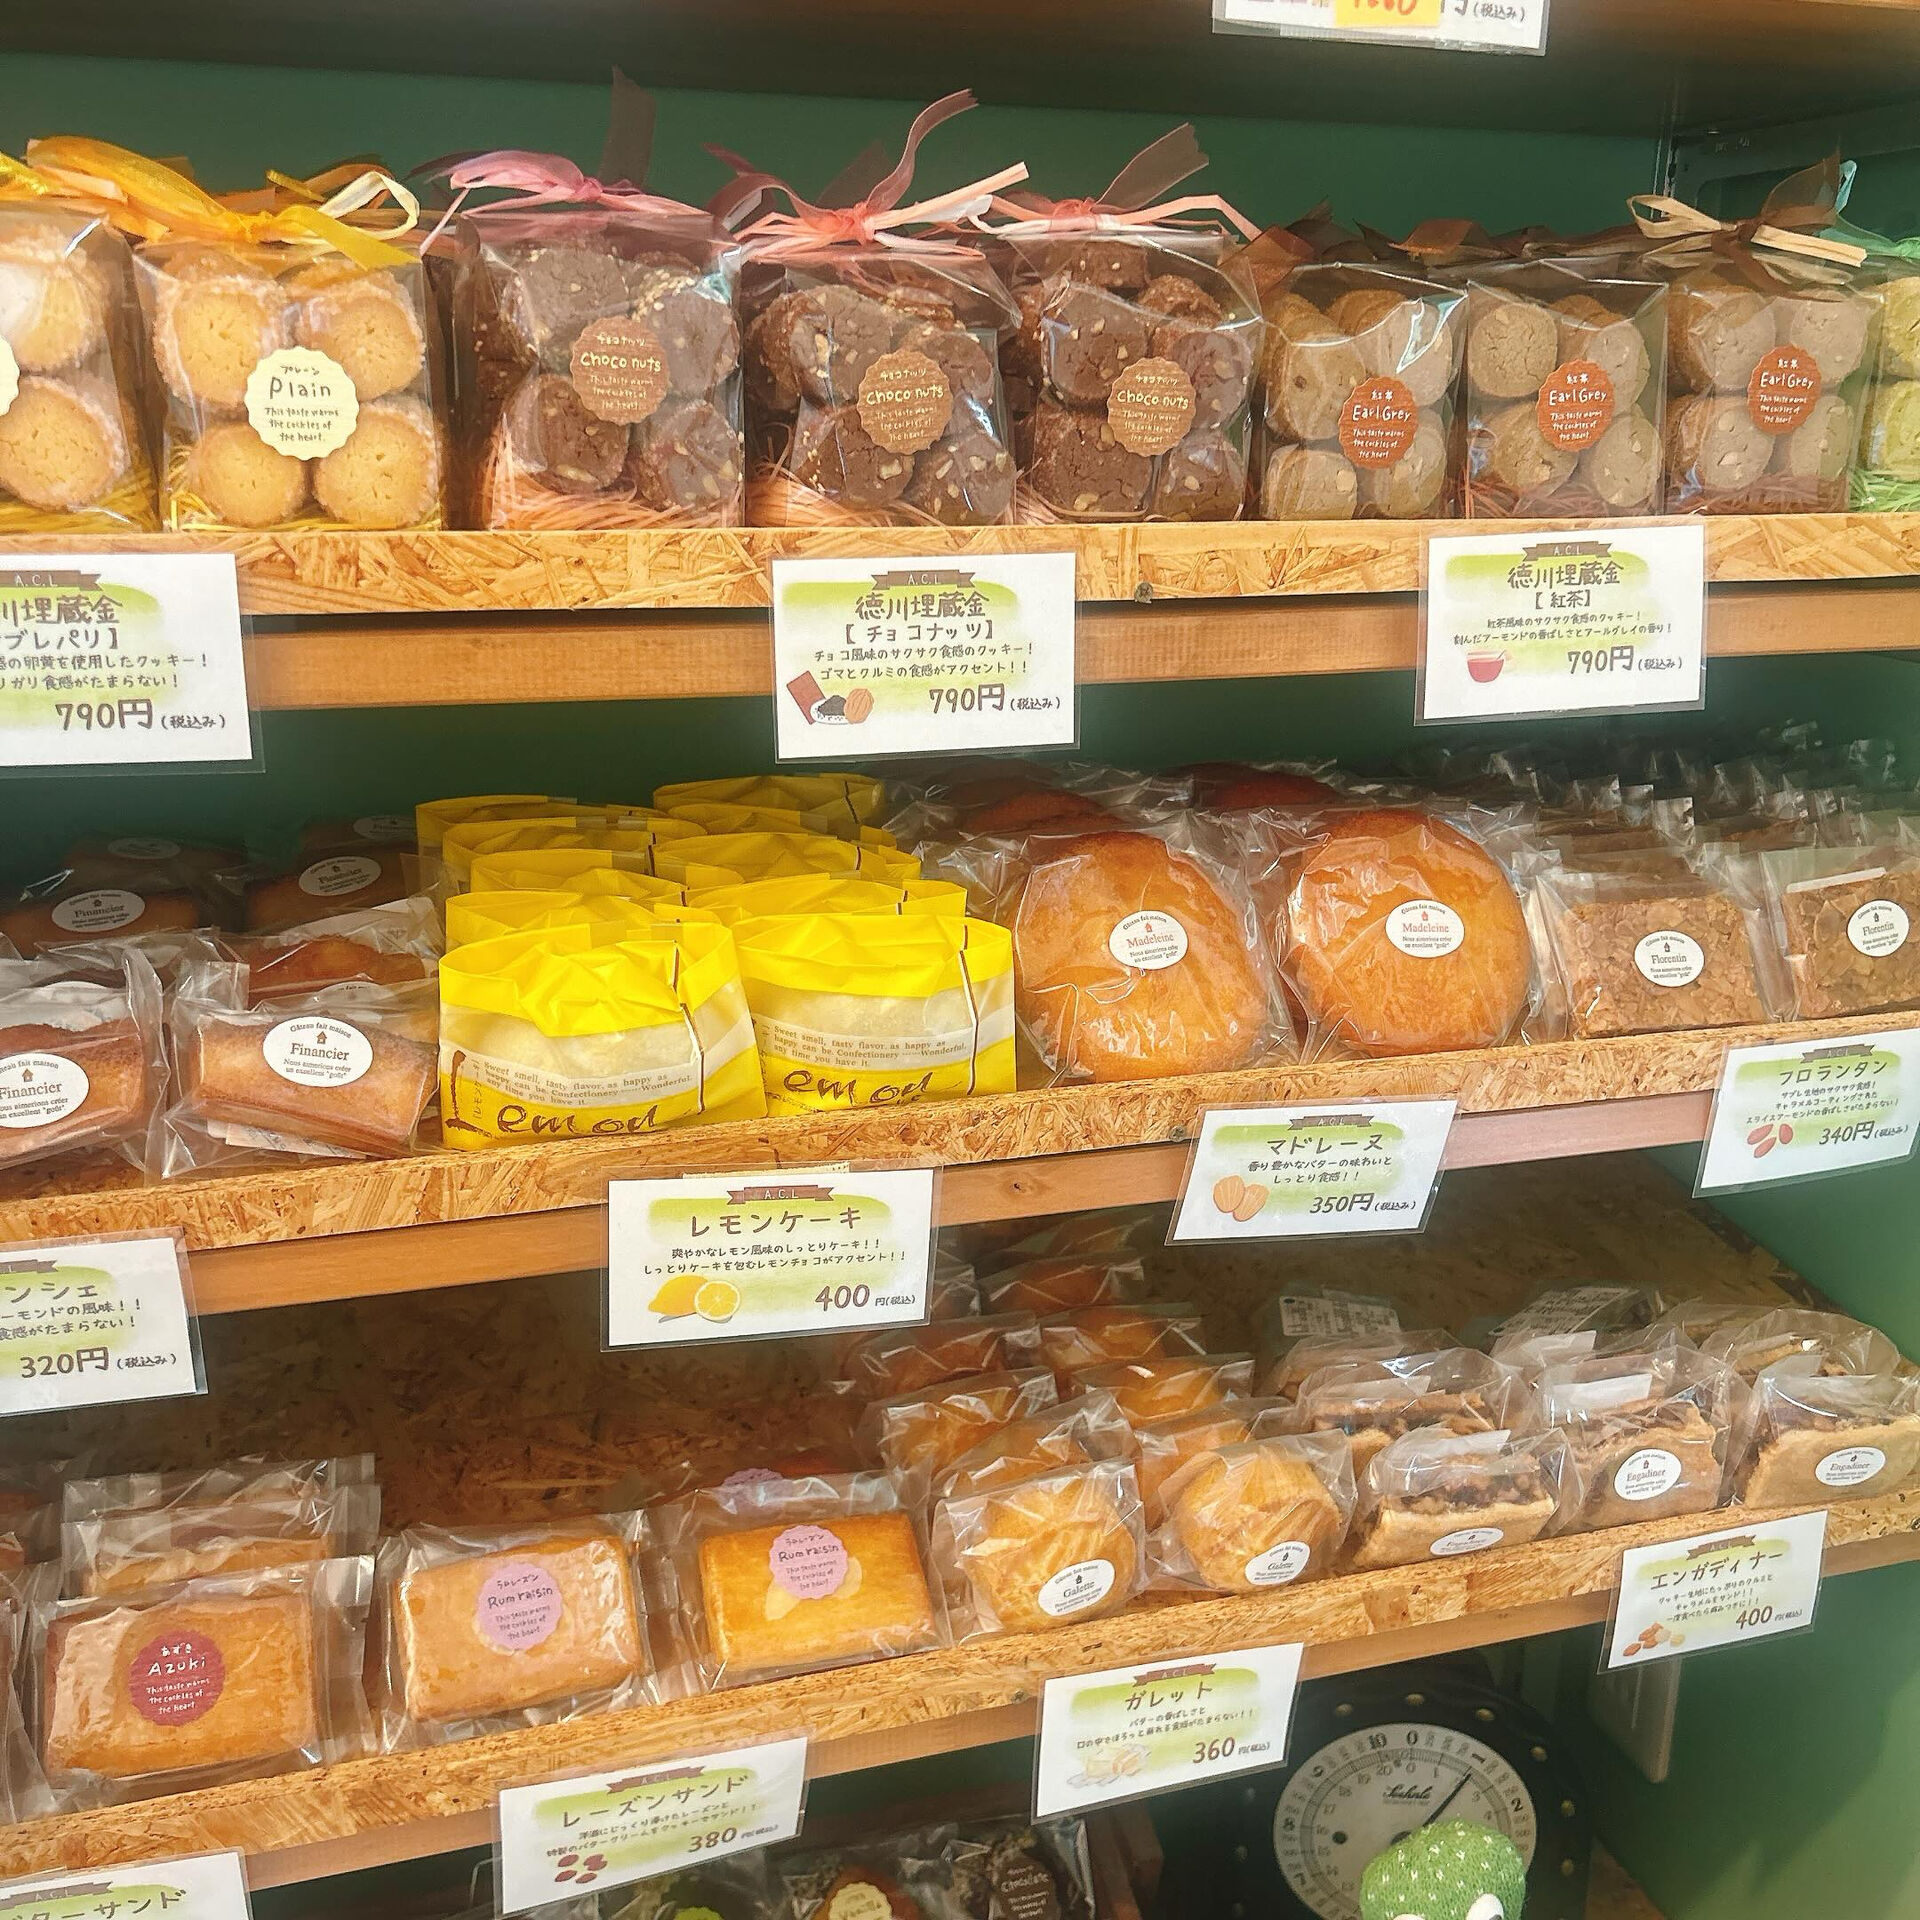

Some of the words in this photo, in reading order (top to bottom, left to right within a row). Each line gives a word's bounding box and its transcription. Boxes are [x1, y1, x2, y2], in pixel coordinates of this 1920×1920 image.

[581, 352, 627, 369] Choco
[632, 357, 661, 373] nuts
[270, 377, 331, 399] Plain
[1760, 372, 1785, 388] Earl
[1787, 374, 1814, 389] Grey
[866, 390, 911, 405] Choco
[915, 384, 944, 398] nuts
[1117, 389, 1159, 406] Choco
[1163, 396, 1189, 410] nuts
[1549, 389, 1576, 406] Earl
[1579, 388, 1607, 402] Grey
[1352, 404, 1380, 421] Earl
[1382, 406, 1411, 422] Grey
[1507, 561, 1624, 589] 徳川埋蔵金
[855, 591, 989, 621] 徳川埋蔵金
[1535, 590, 1591, 609] 【紅茶】
[0, 627, 118, 649] ブレパリ】
[1568, 645, 1634, 674] 790円
[929, 683, 1004, 713] 790円
[1010, 697, 1061, 711] (税込み)
[56, 699, 152, 730] 790円
[161, 715, 225, 729] (税込み)
[1403, 923, 1449, 932] Madeleine
[1126, 934, 1174, 948] Madeleine
[774, 1026, 797, 1038] Sweet
[905, 1042, 931, 1050] happy
[802, 1044, 817, 1052] can
[290, 1042, 350, 1061] Financier
[792, 1049, 811, 1060] time
[835, 1058, 857, 1066] have
[623, 1075, 652, 1087] happy
[1780, 1061, 1888, 1086] フロランタン
[0, 1082, 62, 1099] Financier
[505, 1085, 523, 1096] time
[529, 1093, 545, 1102] you
[551, 1096, 572, 1105] have
[515, 1082, 530, 1090] can
[1819, 1121, 1875, 1145] 340円
[1267, 1135, 1384, 1155] マドレーヌ
[1310, 1193, 1375, 1214] 350円
[691, 1207, 863, 1238] レモンケーキ
[5, 1282, 98, 1303] ンシェ
[815, 1284, 870, 1311] 400
[20, 1346, 109, 1378] 320円
[117, 1353, 177, 1369] (税込み)
[779, 1551, 804, 1562] Rum
[806, 1545, 839, 1556] raisin
[1651, 1551, 1783, 1591] エンガディナー
[488, 1596, 515, 1610] Rum
[517, 1587, 553, 1600] raisin
[1736, 1606, 1772, 1630] 400
[147, 1657, 206, 1676] Azuki
[1125, 1682, 1213, 1711] ガレット
[1193, 1737, 1235, 1764] 360
[563, 1776, 748, 1828] レーズンサンド
[688, 1828, 737, 1853] 380
